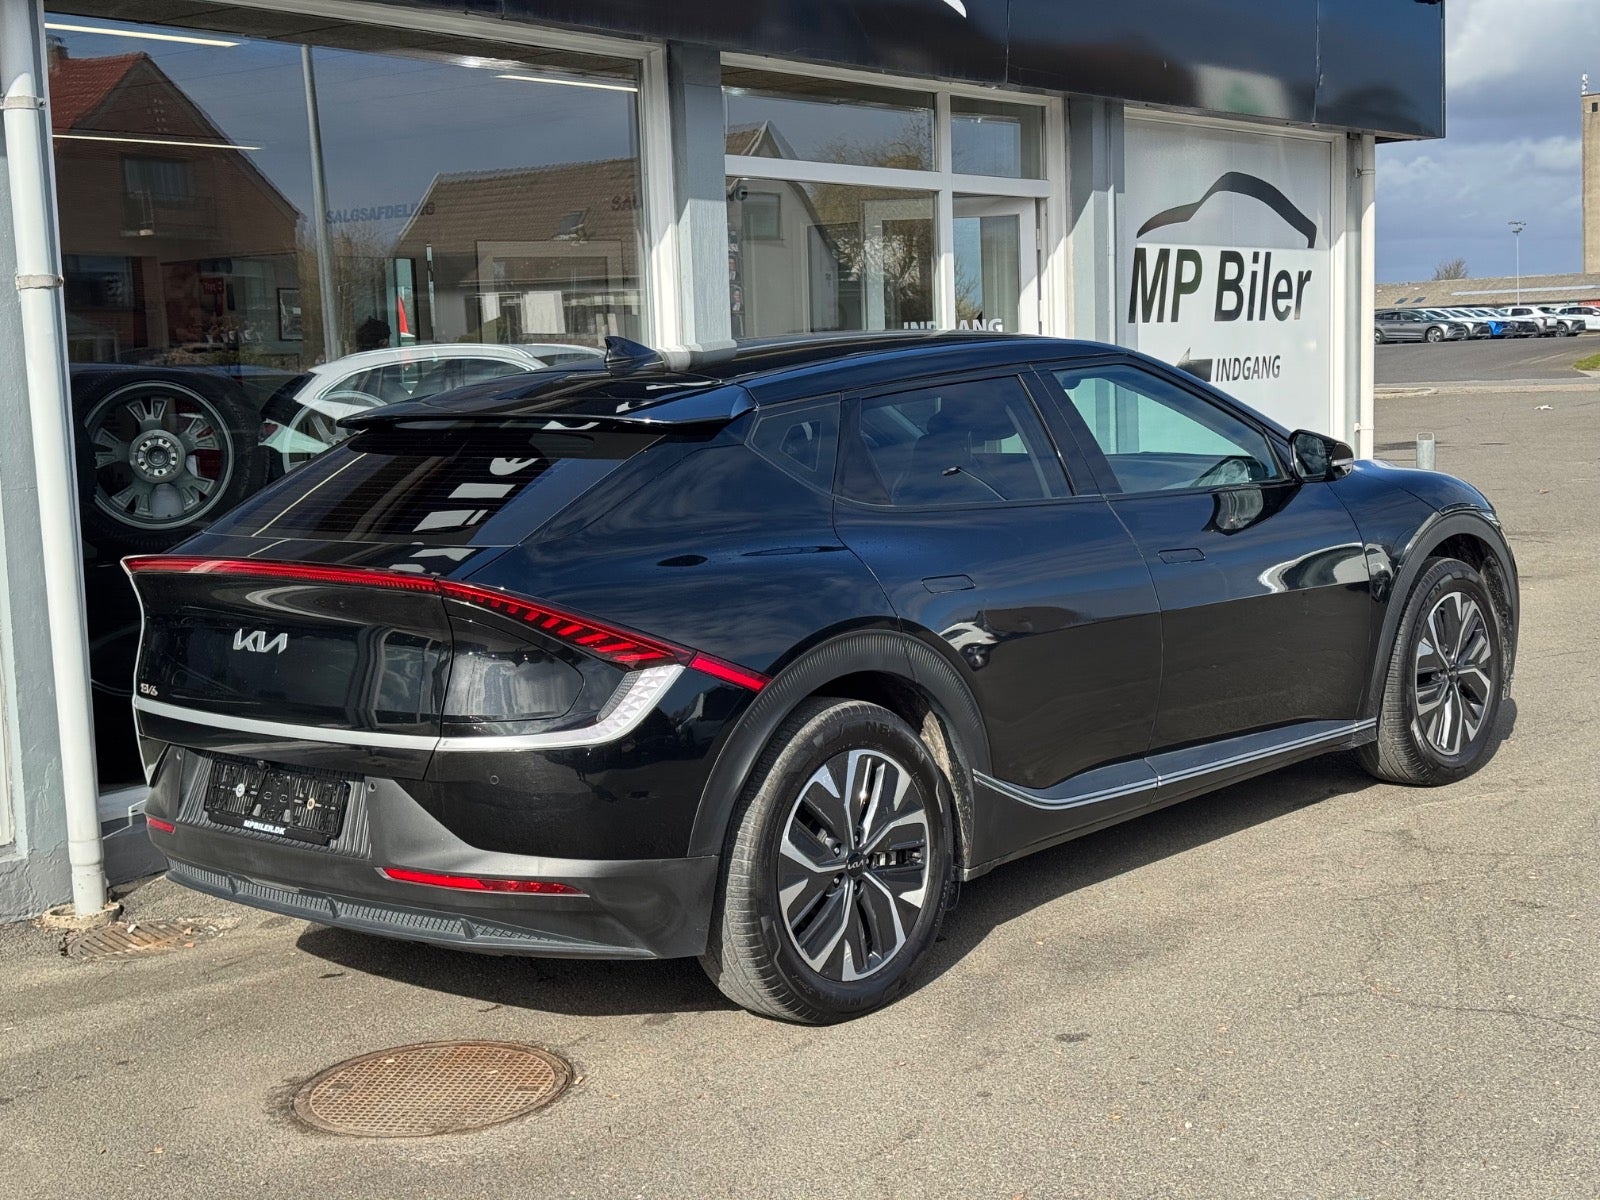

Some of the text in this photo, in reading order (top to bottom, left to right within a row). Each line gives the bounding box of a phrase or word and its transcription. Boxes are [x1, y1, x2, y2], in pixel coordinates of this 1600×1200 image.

[1127, 247, 1312, 324] MP Biler
[903, 318, 1004, 332] INANG
[1215, 355, 1281, 382] INDGANG
[232, 628, 288, 655] KIA
[140, 682, 159, 697] EV6
